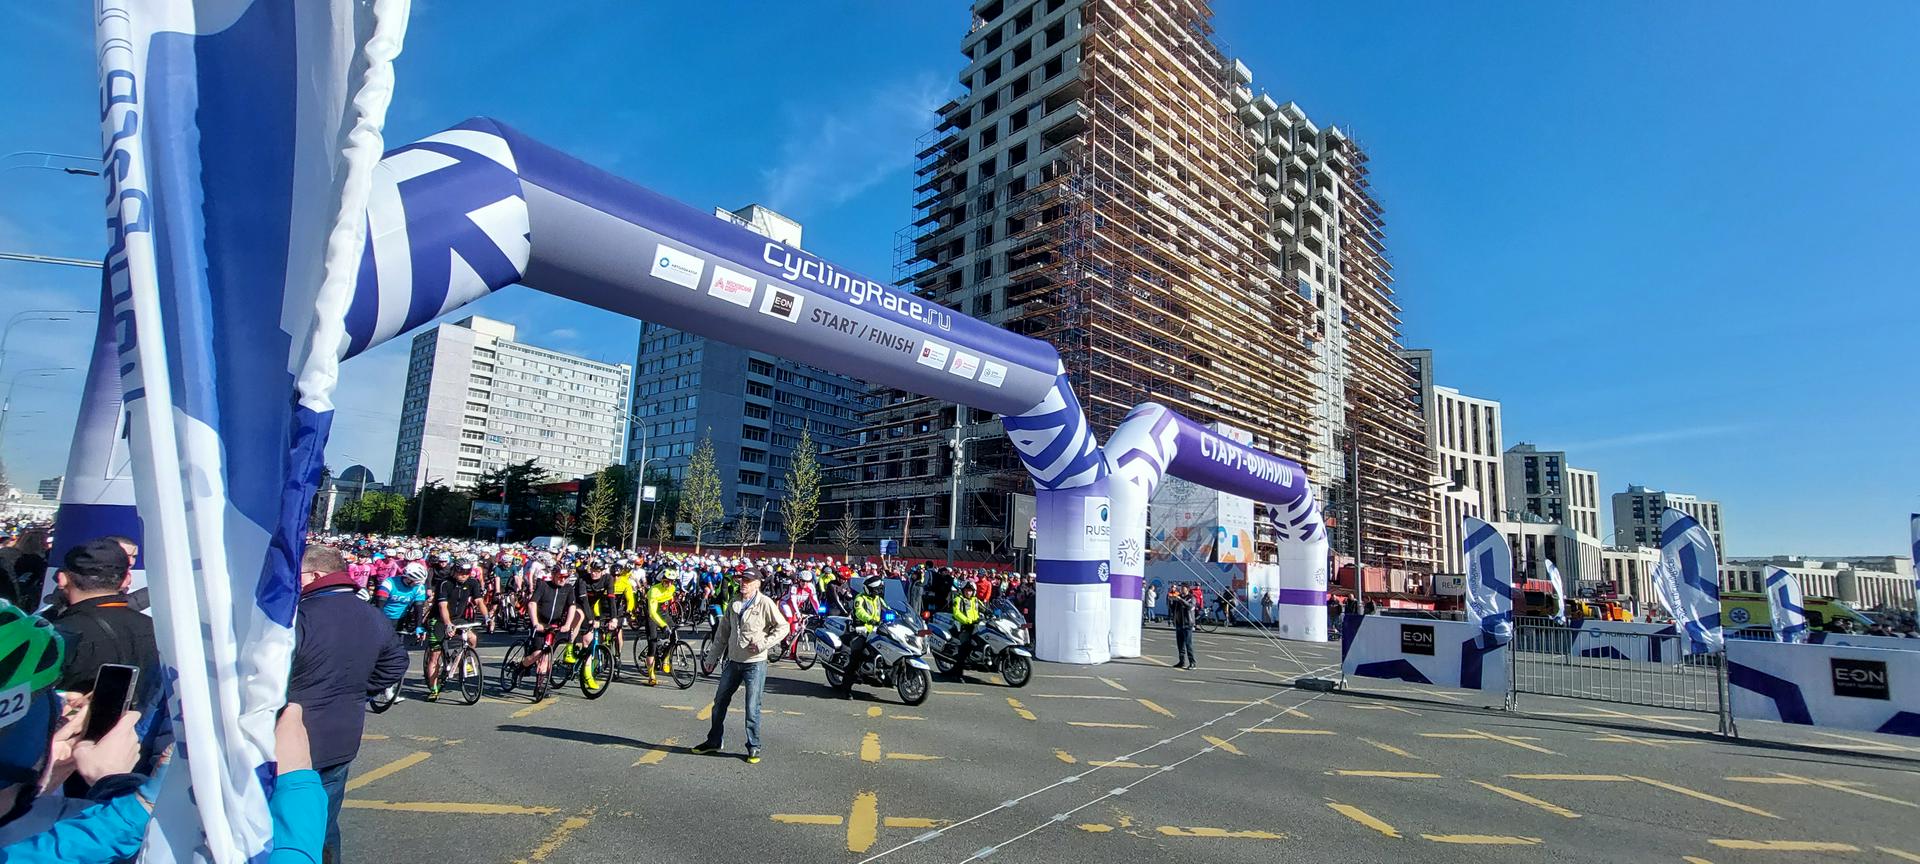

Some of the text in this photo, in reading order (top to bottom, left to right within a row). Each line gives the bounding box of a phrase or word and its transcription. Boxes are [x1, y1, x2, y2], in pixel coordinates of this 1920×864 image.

[763, 241, 952, 332] CyclingRace.ru
[810, 307, 859, 339] START
[868, 327, 916, 355] FINISH
[1200, 430, 1293, 489] СТАРТ-ФИНИШ
[1835, 667, 1885, 684] EON
